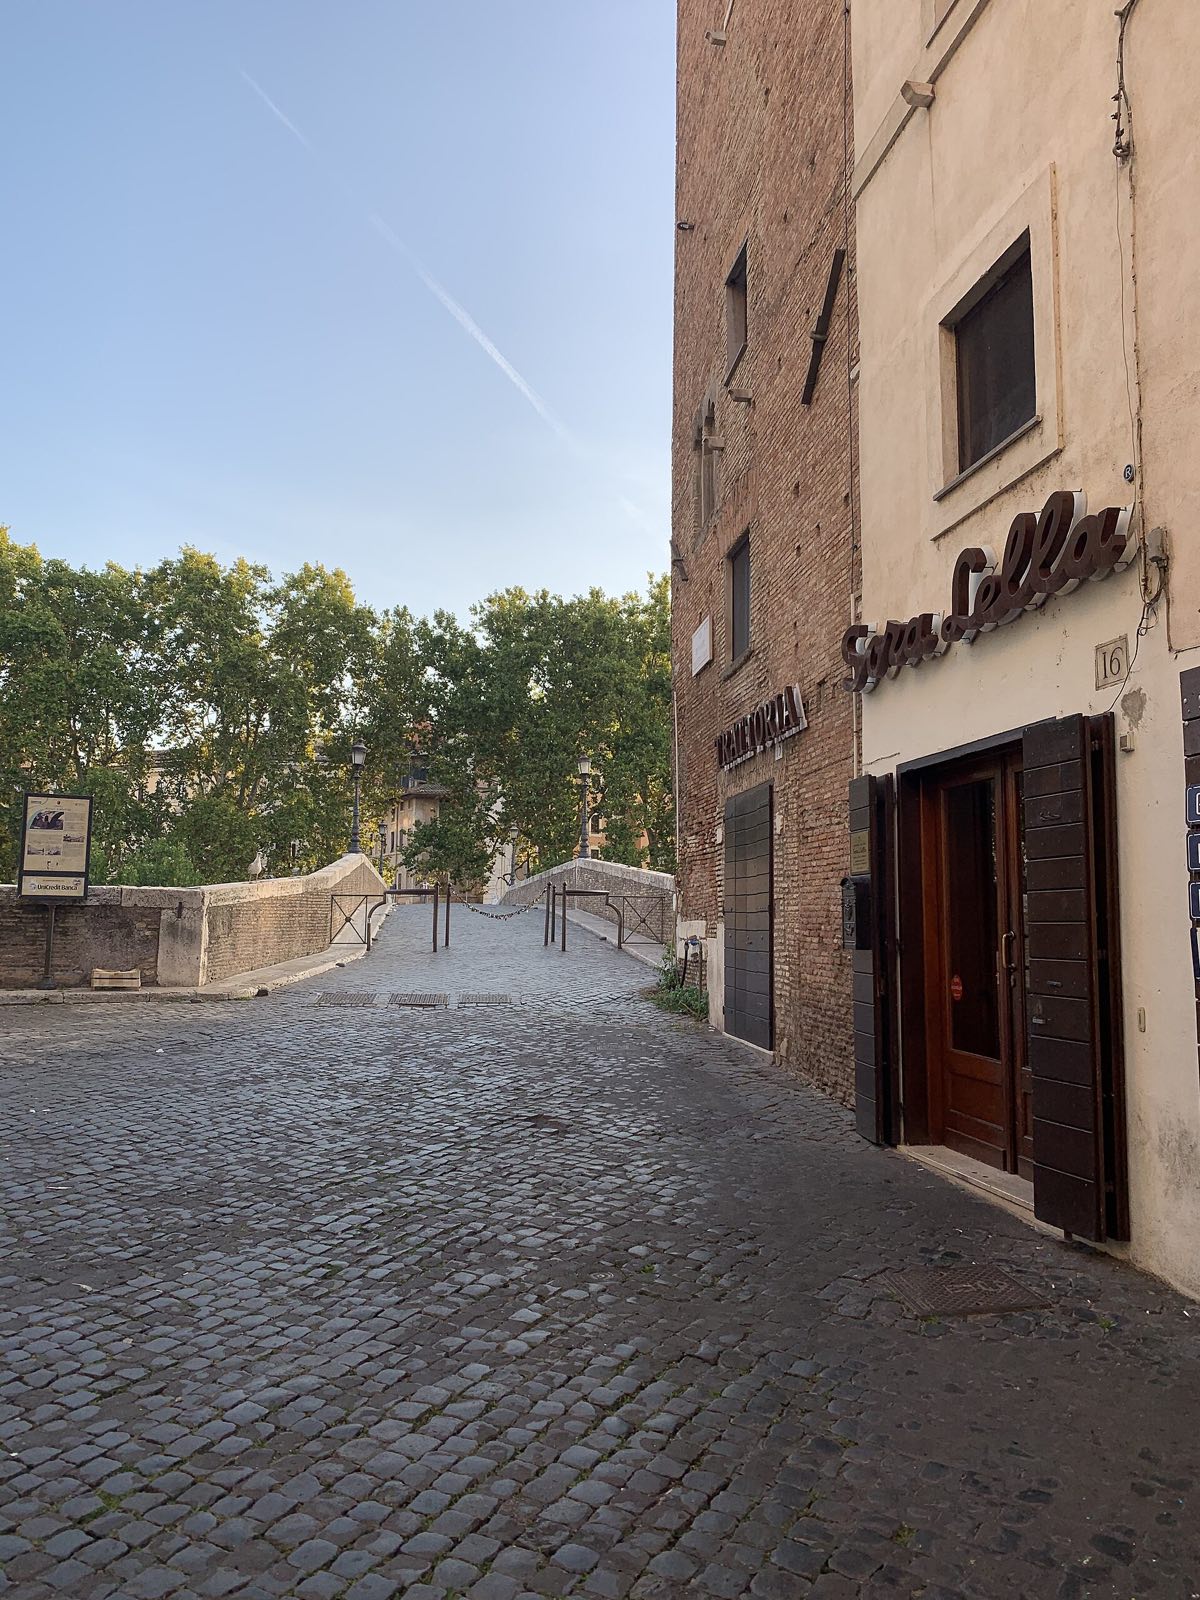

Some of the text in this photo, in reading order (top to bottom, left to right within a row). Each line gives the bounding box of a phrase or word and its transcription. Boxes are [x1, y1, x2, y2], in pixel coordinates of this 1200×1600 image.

[841, 490, 1132, 692] Sora Lella
[1102, 646, 1123, 679] 16
[714, 683, 807, 771] TRATTORIA
